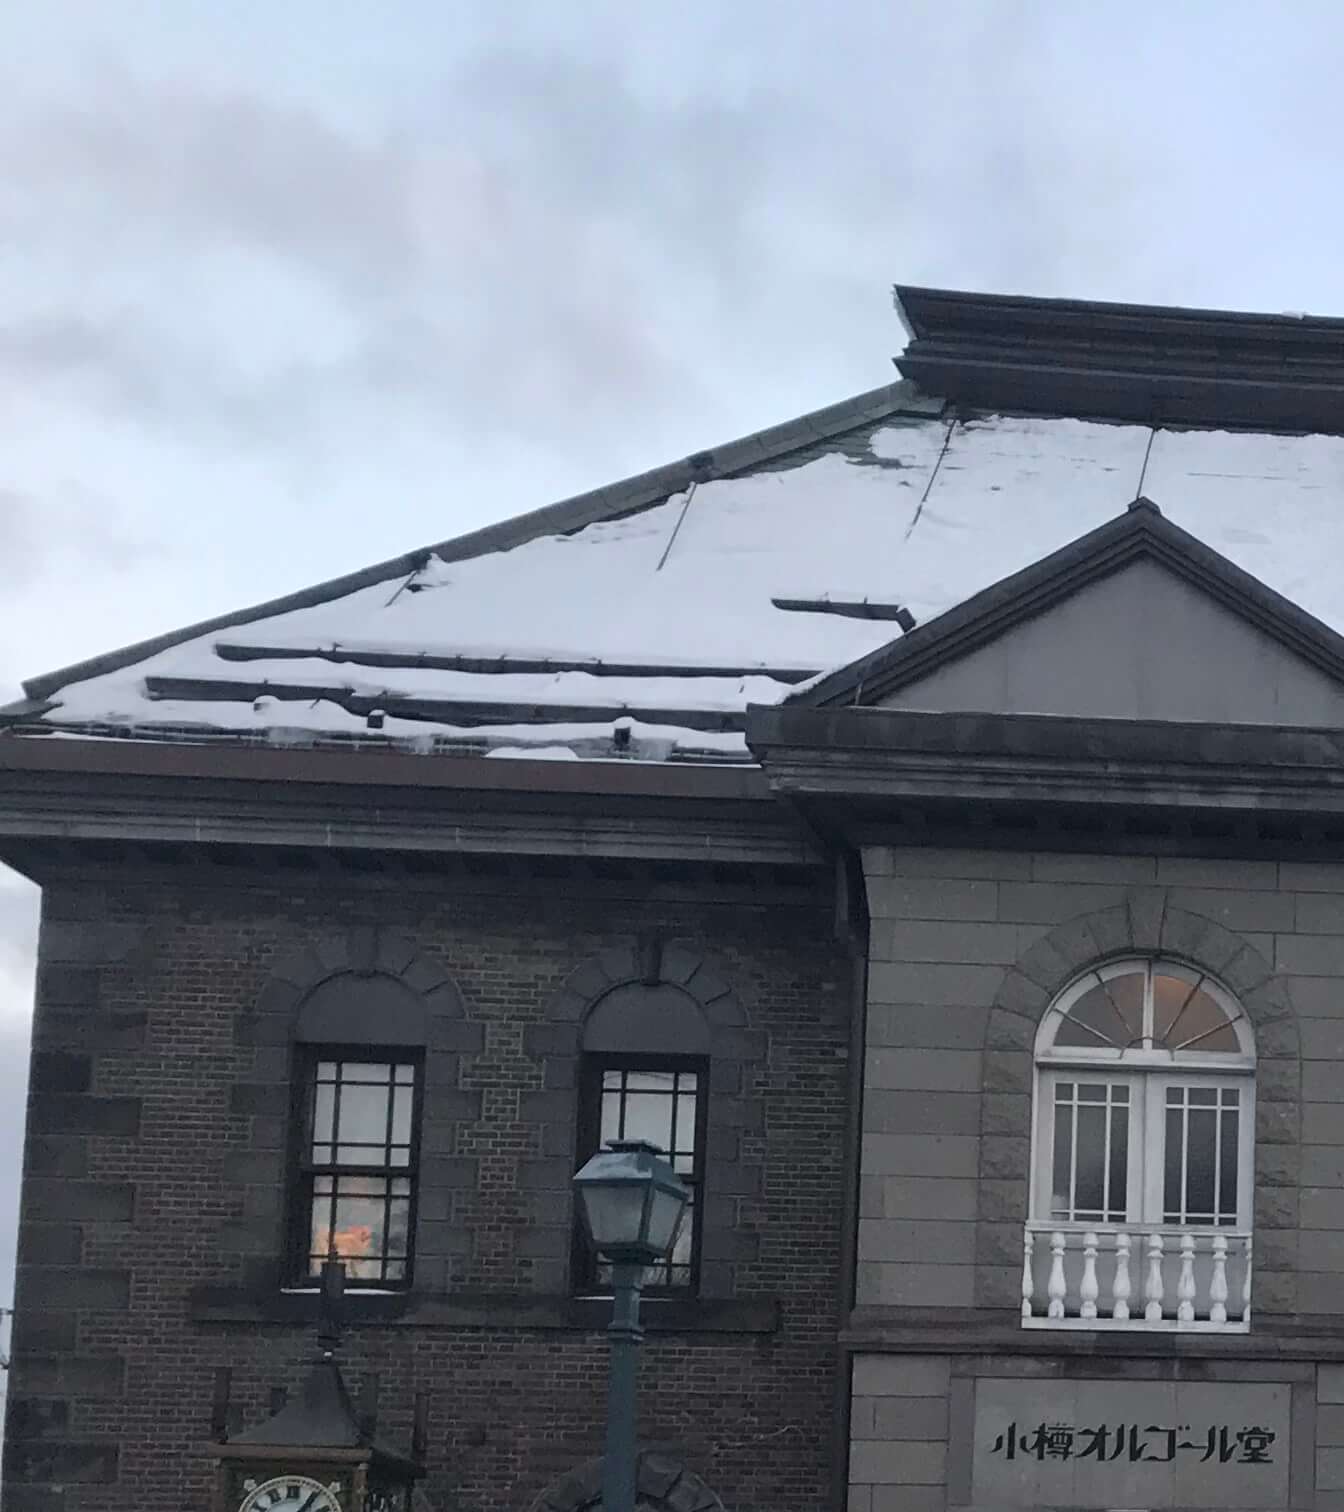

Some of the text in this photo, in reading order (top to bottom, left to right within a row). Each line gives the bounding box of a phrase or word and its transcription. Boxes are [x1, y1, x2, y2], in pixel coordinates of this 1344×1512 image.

[990, 1422, 1276, 1464] 小樽オルゴール堂
